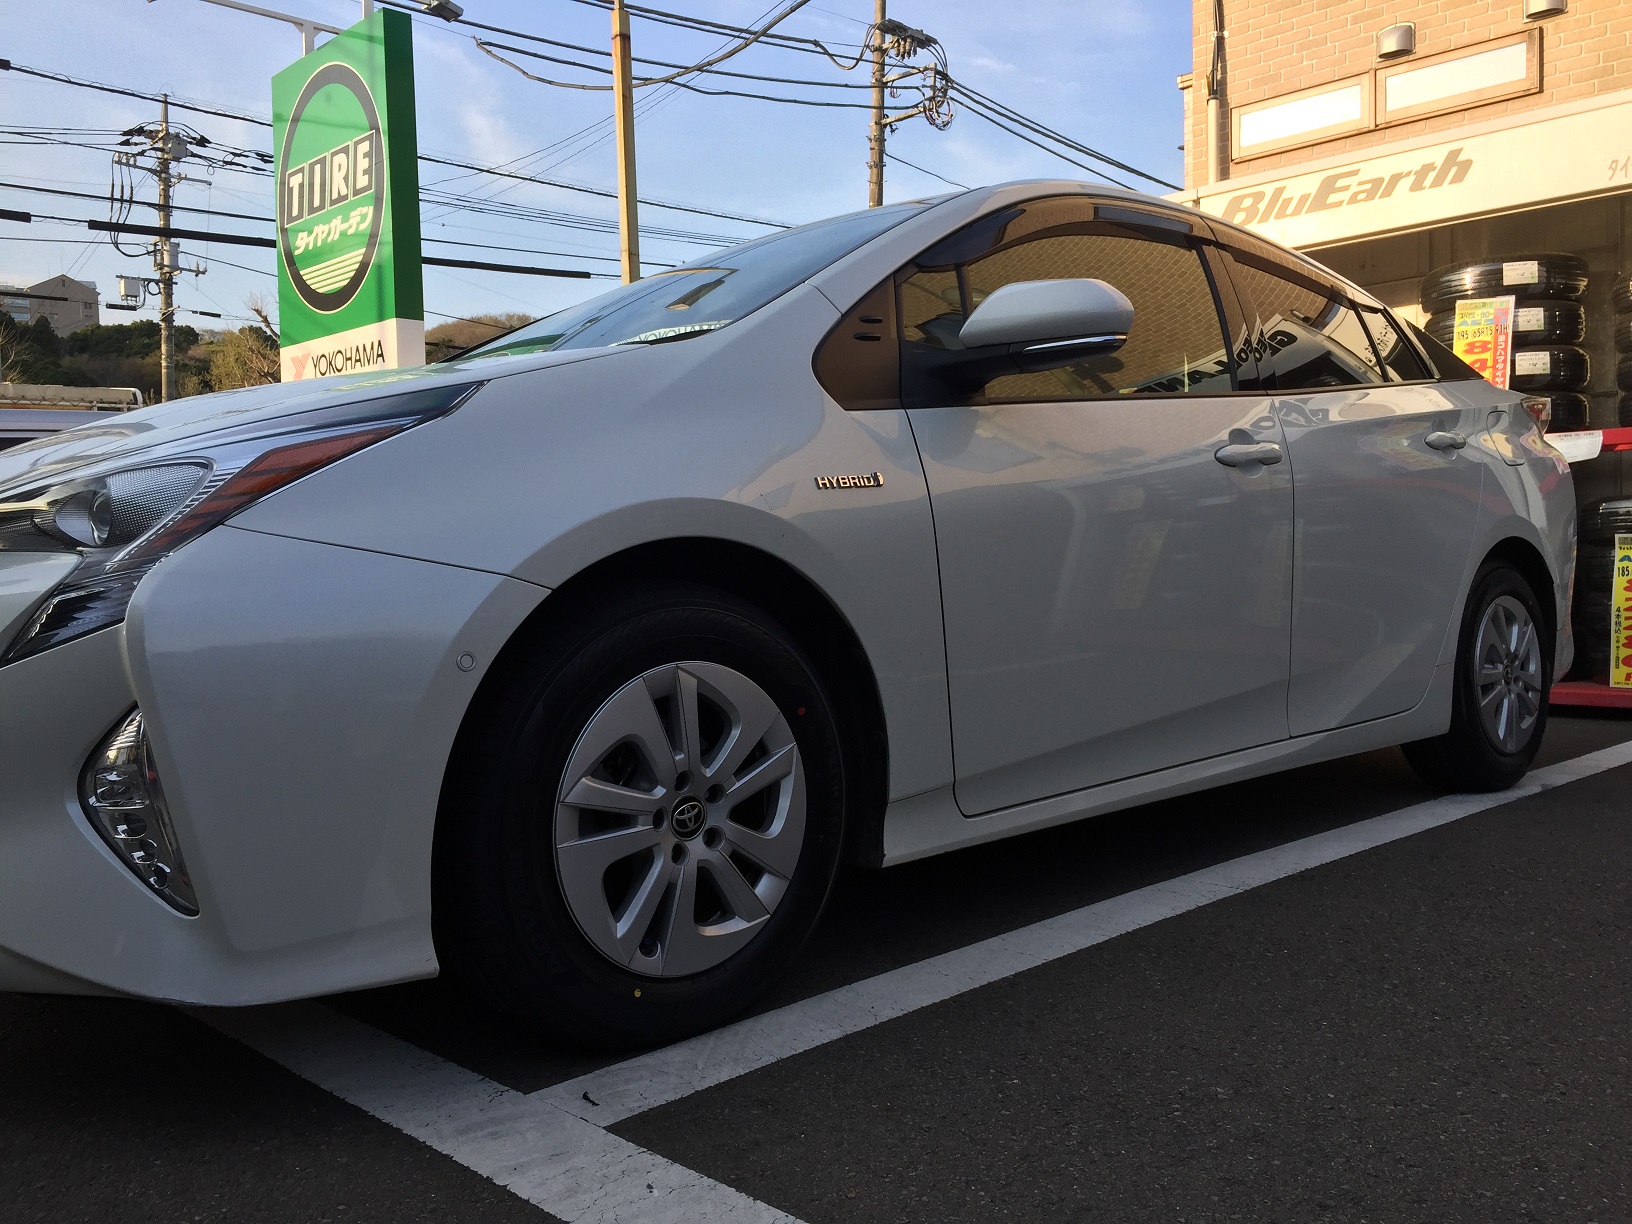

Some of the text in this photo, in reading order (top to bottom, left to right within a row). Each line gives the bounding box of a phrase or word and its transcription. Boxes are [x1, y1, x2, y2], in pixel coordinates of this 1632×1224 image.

[288, 139, 370, 218] TIRE
[1221, 147, 1474, 227] BluEarth
[1608, 155, 1632, 182] タイ
[294, 205, 374, 256] タイヤガーデン
[312, 340, 385, 377] YOKOHAMA
[814, 474, 876, 490] HYBRID
